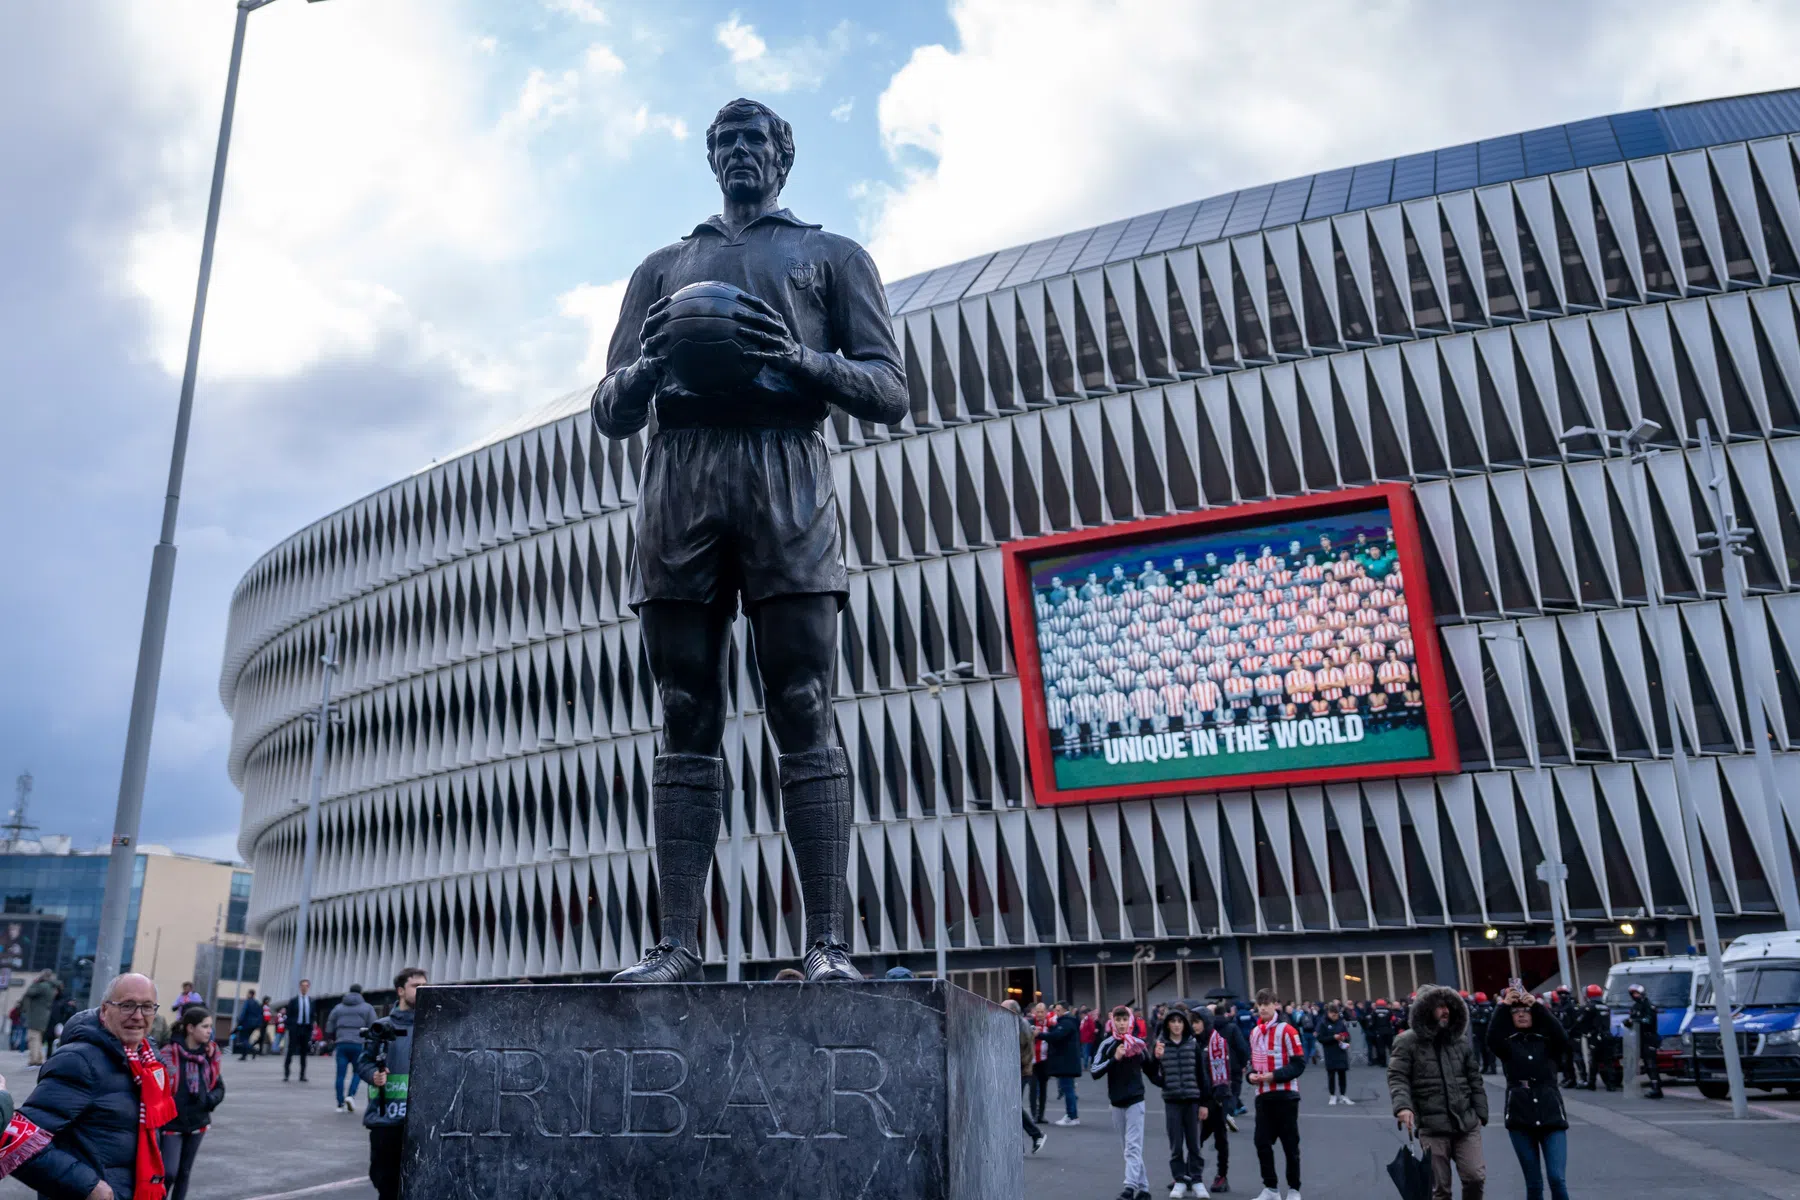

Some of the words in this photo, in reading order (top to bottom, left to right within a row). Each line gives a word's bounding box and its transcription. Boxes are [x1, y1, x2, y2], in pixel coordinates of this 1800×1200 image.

[1103, 732, 1188, 765] UNIQUE
[1191, 728, 1218, 756] IN
[1225, 723, 1269, 753] THE
[1272, 714, 1365, 749] WORLD
[1133, 944, 1156, 963] 23
[440, 1045, 906, 1139] IRIBAR
